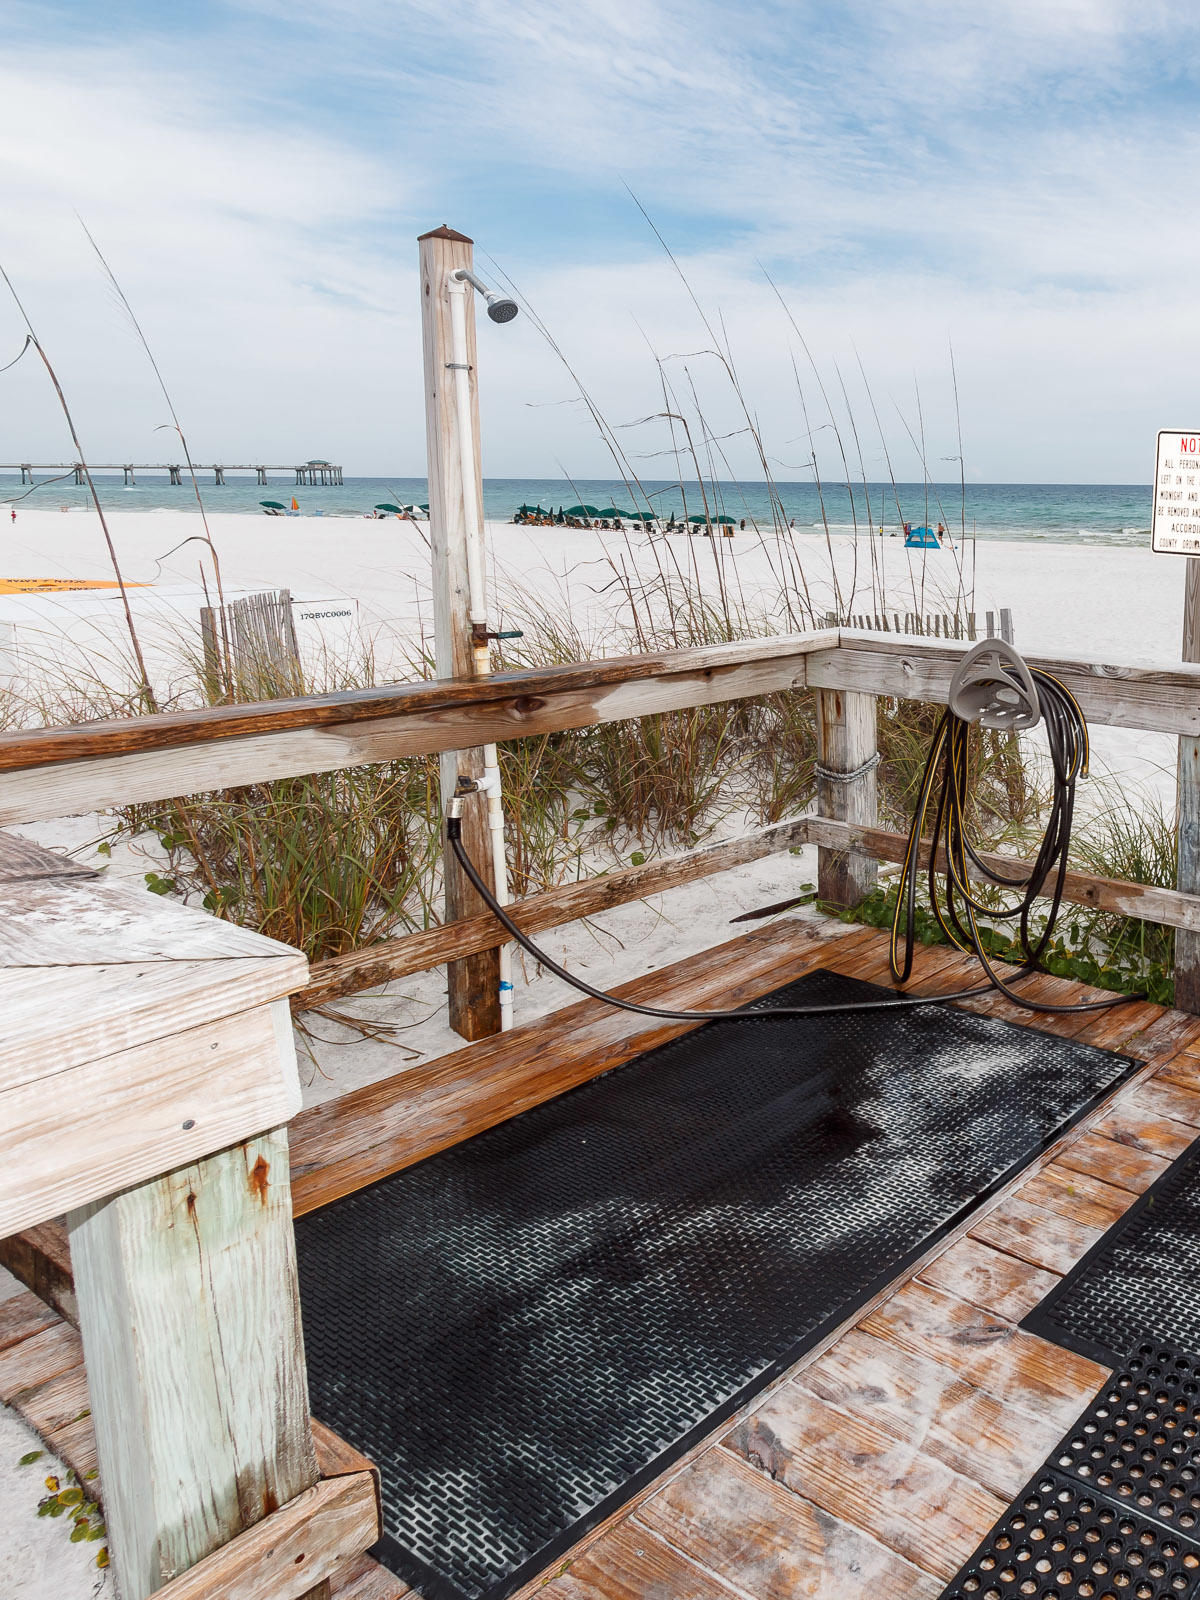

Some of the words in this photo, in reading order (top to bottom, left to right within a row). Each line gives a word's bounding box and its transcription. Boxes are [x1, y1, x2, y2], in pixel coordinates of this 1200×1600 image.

[1164, 459, 1174, 469] ALL
[1160, 474, 1171, 485] LEFT
[1175, 475, 1182, 485] ON
[1186, 475, 1195, 486] THE
[1160, 490, 1183, 501] MIDNIGHT
[1187, 491, 1198, 502] AND
[1157, 506, 1164, 516] BE
[1167, 506, 1189, 517] REMOVED
[1159, 537, 1178, 548] COUNTY
